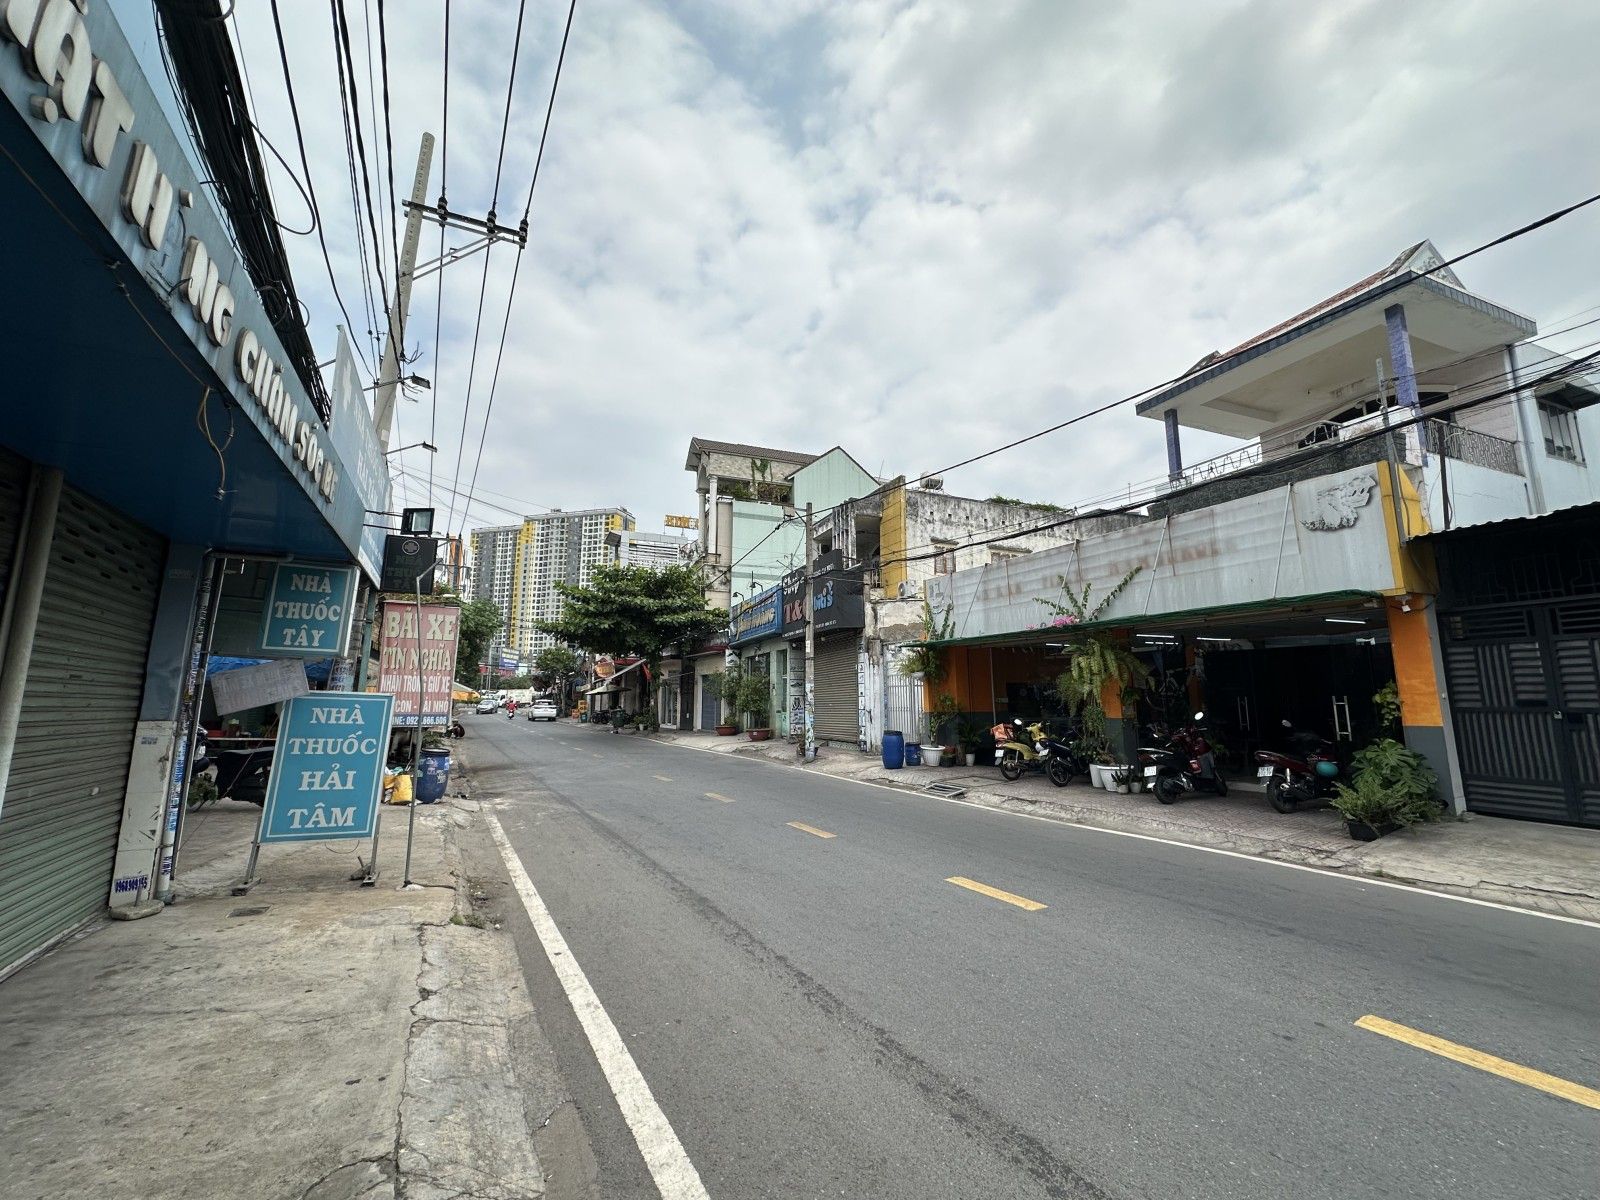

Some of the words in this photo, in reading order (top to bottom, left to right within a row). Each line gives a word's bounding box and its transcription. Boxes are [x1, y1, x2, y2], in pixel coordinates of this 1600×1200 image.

[292, 420, 324, 484] SÓC
[290, 571, 332, 593] NHÀ
[274, 595, 342, 622] THUỐC
[283, 625, 326, 648] TÂY
[427, 613, 457, 640] XE
[383, 641, 408, 669] TÍN
[409, 643, 452, 672] NGHĨA
[441, 676, 451, 693] XE
[310, 702, 365, 725] NHÀ
[289, 729, 377, 756] THUỐC
[298, 763, 357, 791] HẢI
[287, 801, 357, 830] TÂM
